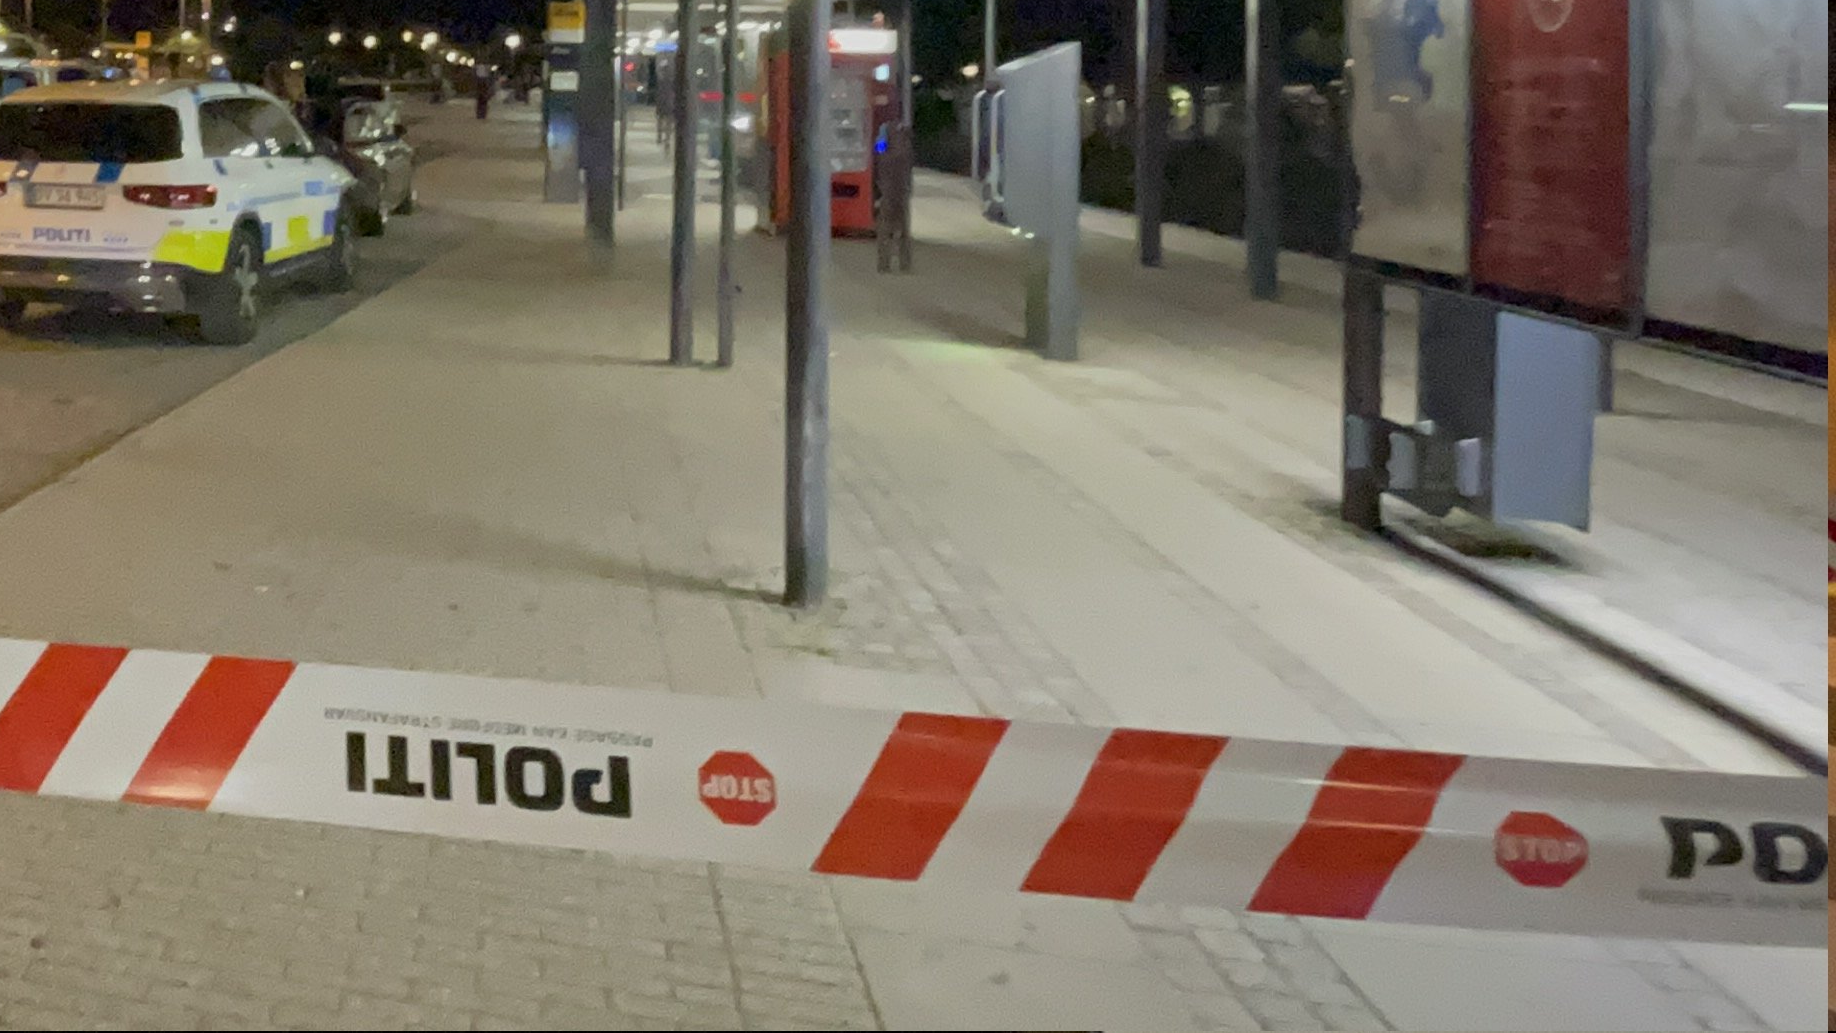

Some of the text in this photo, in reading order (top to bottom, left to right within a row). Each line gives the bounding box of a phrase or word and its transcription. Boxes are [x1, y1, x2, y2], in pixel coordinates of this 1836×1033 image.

[32, 226, 91, 243] POLITI
[346, 731, 632, 818] POLITI
[701, 775, 773, 802] STOP
[1498, 835, 1585, 863] STOP
